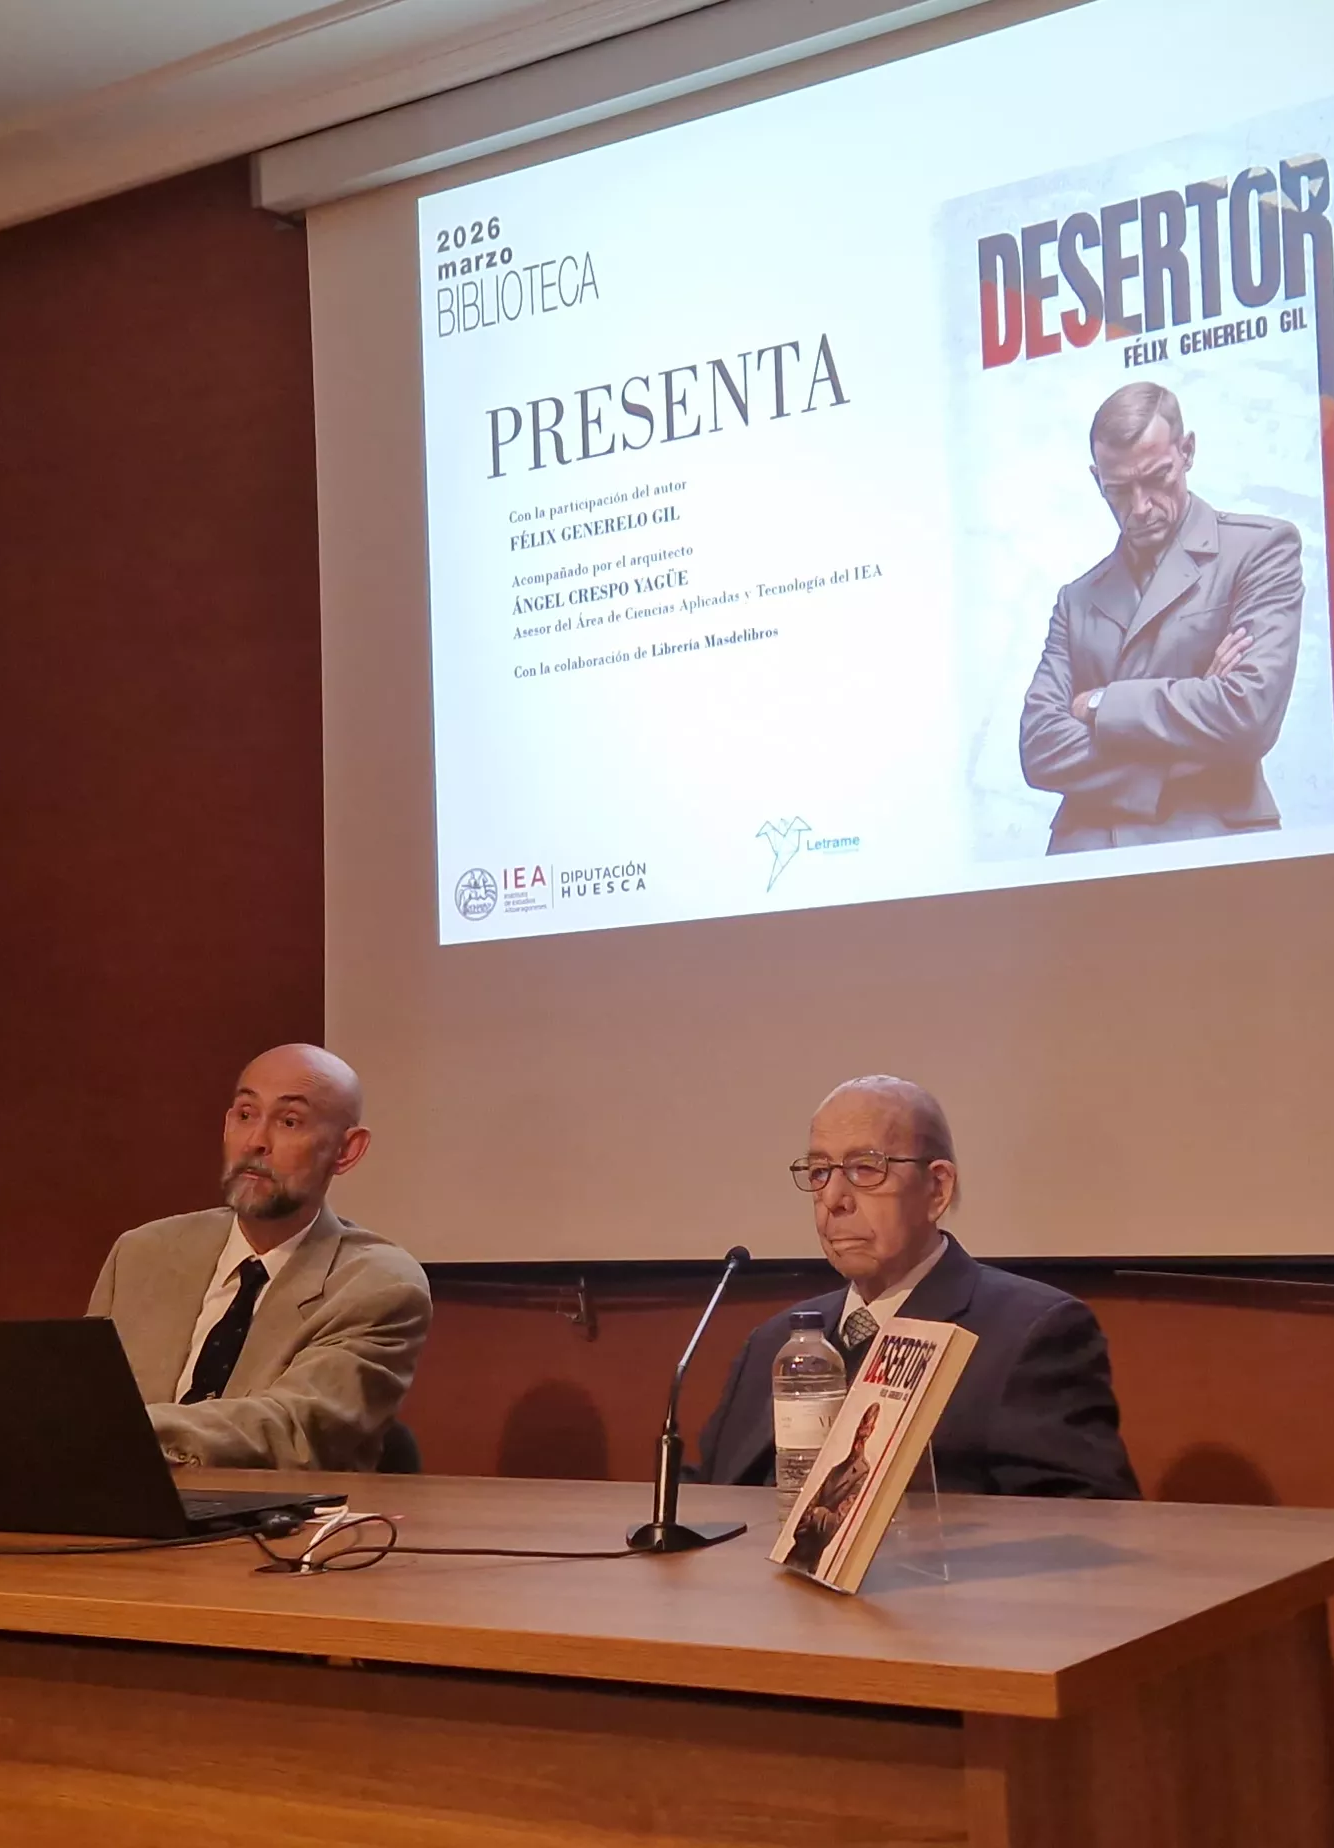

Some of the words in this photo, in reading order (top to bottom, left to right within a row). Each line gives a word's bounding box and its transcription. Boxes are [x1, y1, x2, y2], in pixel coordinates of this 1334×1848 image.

[436, 216, 501, 253] 2026
[437, 246, 513, 281] marzo
[978, 152, 1334, 370] DESERTOR
[437, 251, 599, 337] BIBLIOTECA
[1124, 338, 1168, 369] FÉLIX
[1180, 315, 1268, 357] GENERELO
[1279, 307, 1308, 333] GIL
[485, 332, 851, 480] PRESENTA
[509, 510, 531, 524] Con
[535, 506, 545, 519] la
[549, 492, 628, 520] participación
[632, 484, 650, 500] del
[653, 480, 687, 496] autor
[510, 529, 557, 551] FÉLIX
[561, 512, 648, 542] GENERELO
[652, 505, 680, 525] GIL
[511, 563, 588, 588] Acompañado
[592, 561, 612, 577] por
[616, 555, 626, 569] el
[630, 546, 693, 568] arquitecto
[512, 592, 565, 615] ÁNGEL
[569, 581, 629, 604] CRESPO
[634, 568, 689, 594] YAGÜE
[513, 623, 551, 640] Asesor
[555, 618, 572, 633] del
[576, 612, 603, 630] Área
[607, 610, 621, 624] de
[625, 602, 675, 621] Ciencias
[679, 591, 740, 614] Aplicadas
[744, 591, 752, 604] y
[756, 576, 825, 597] Tecnología
[830, 568, 849, 584] del
[854, 564, 883, 581] IEA
[514, 665, 536, 679] Con
[540, 661, 551, 675] la
[554, 651, 630, 672] colaboración
[634, 646, 648, 659] de
[651, 639, 700, 657] Librería
[704, 627, 779, 649] Masdelibros
[807, 836, 860, 851] Letrame
[503, 865, 547, 890] IEA
[561, 860, 646, 884] DIPUTACIÓN
[561, 878, 646, 898] HUESCA
[863, 1335, 937, 1390] DESERTOR
